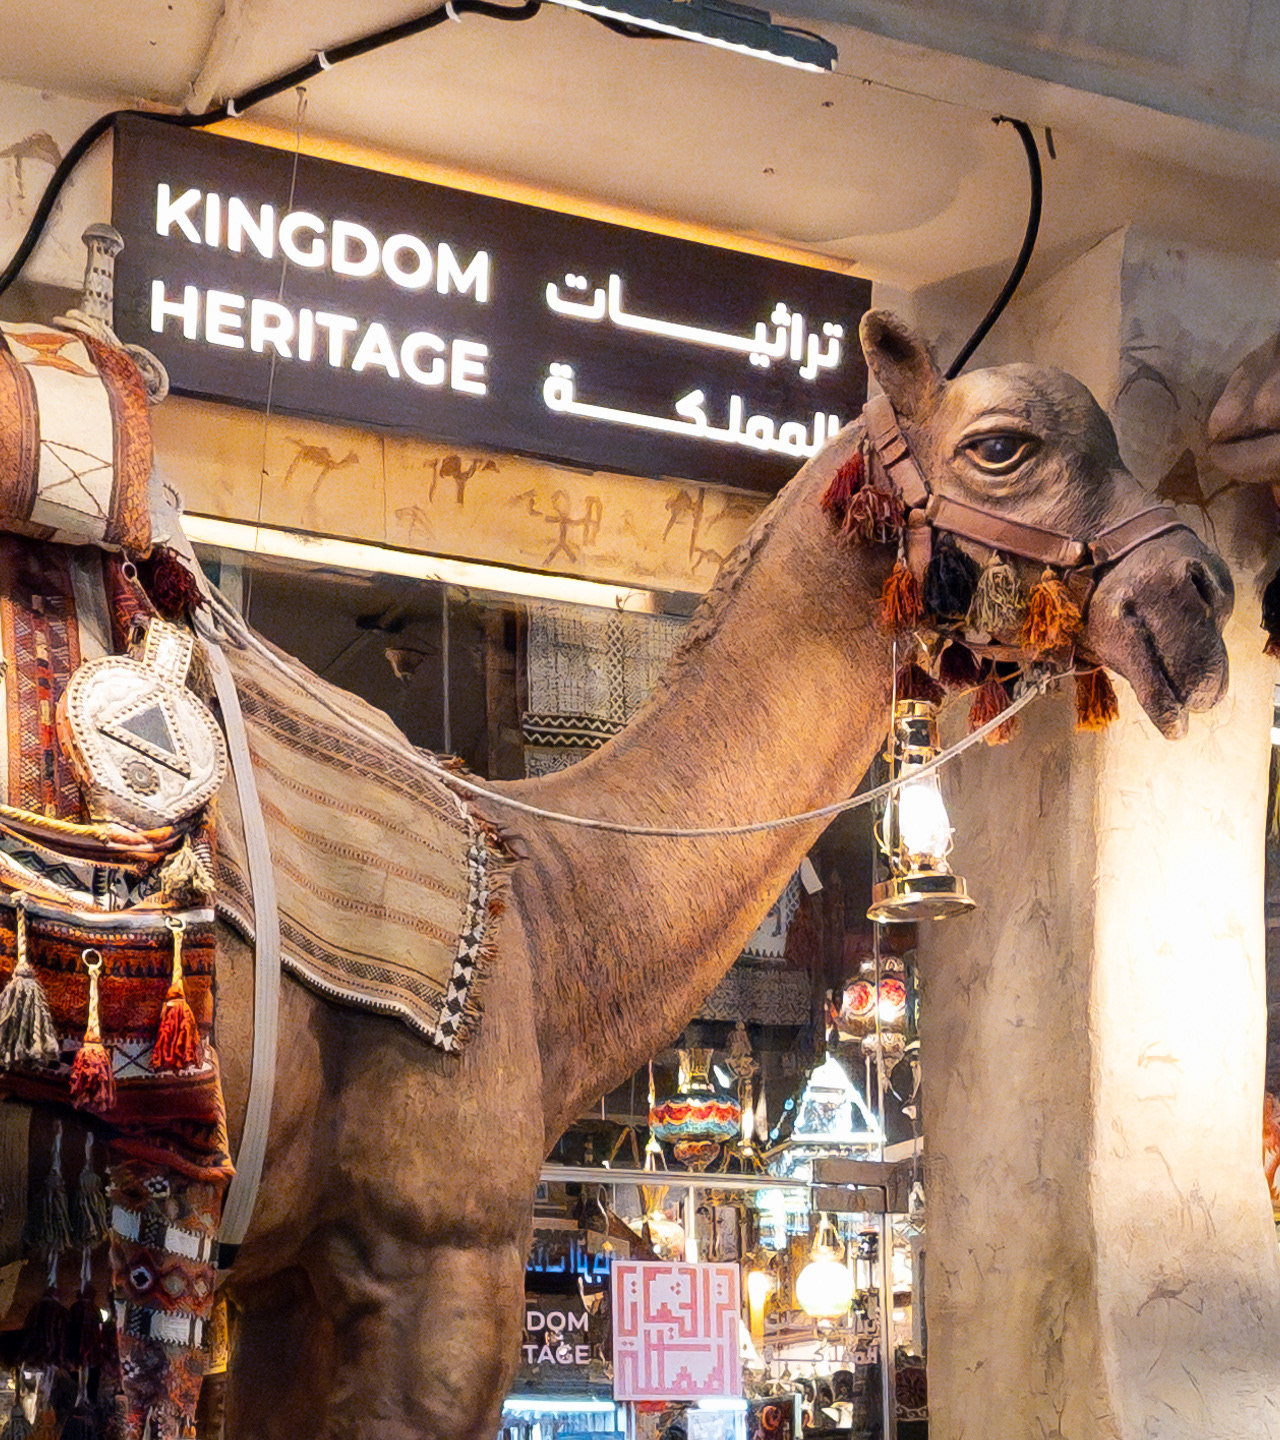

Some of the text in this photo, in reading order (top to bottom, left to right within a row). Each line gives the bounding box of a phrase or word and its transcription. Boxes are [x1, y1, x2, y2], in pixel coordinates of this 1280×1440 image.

[155, 182, 490, 304] KINGDOM
[150, 279, 489, 395] HERITAGE
[545, 273, 844, 381] تراثيات
